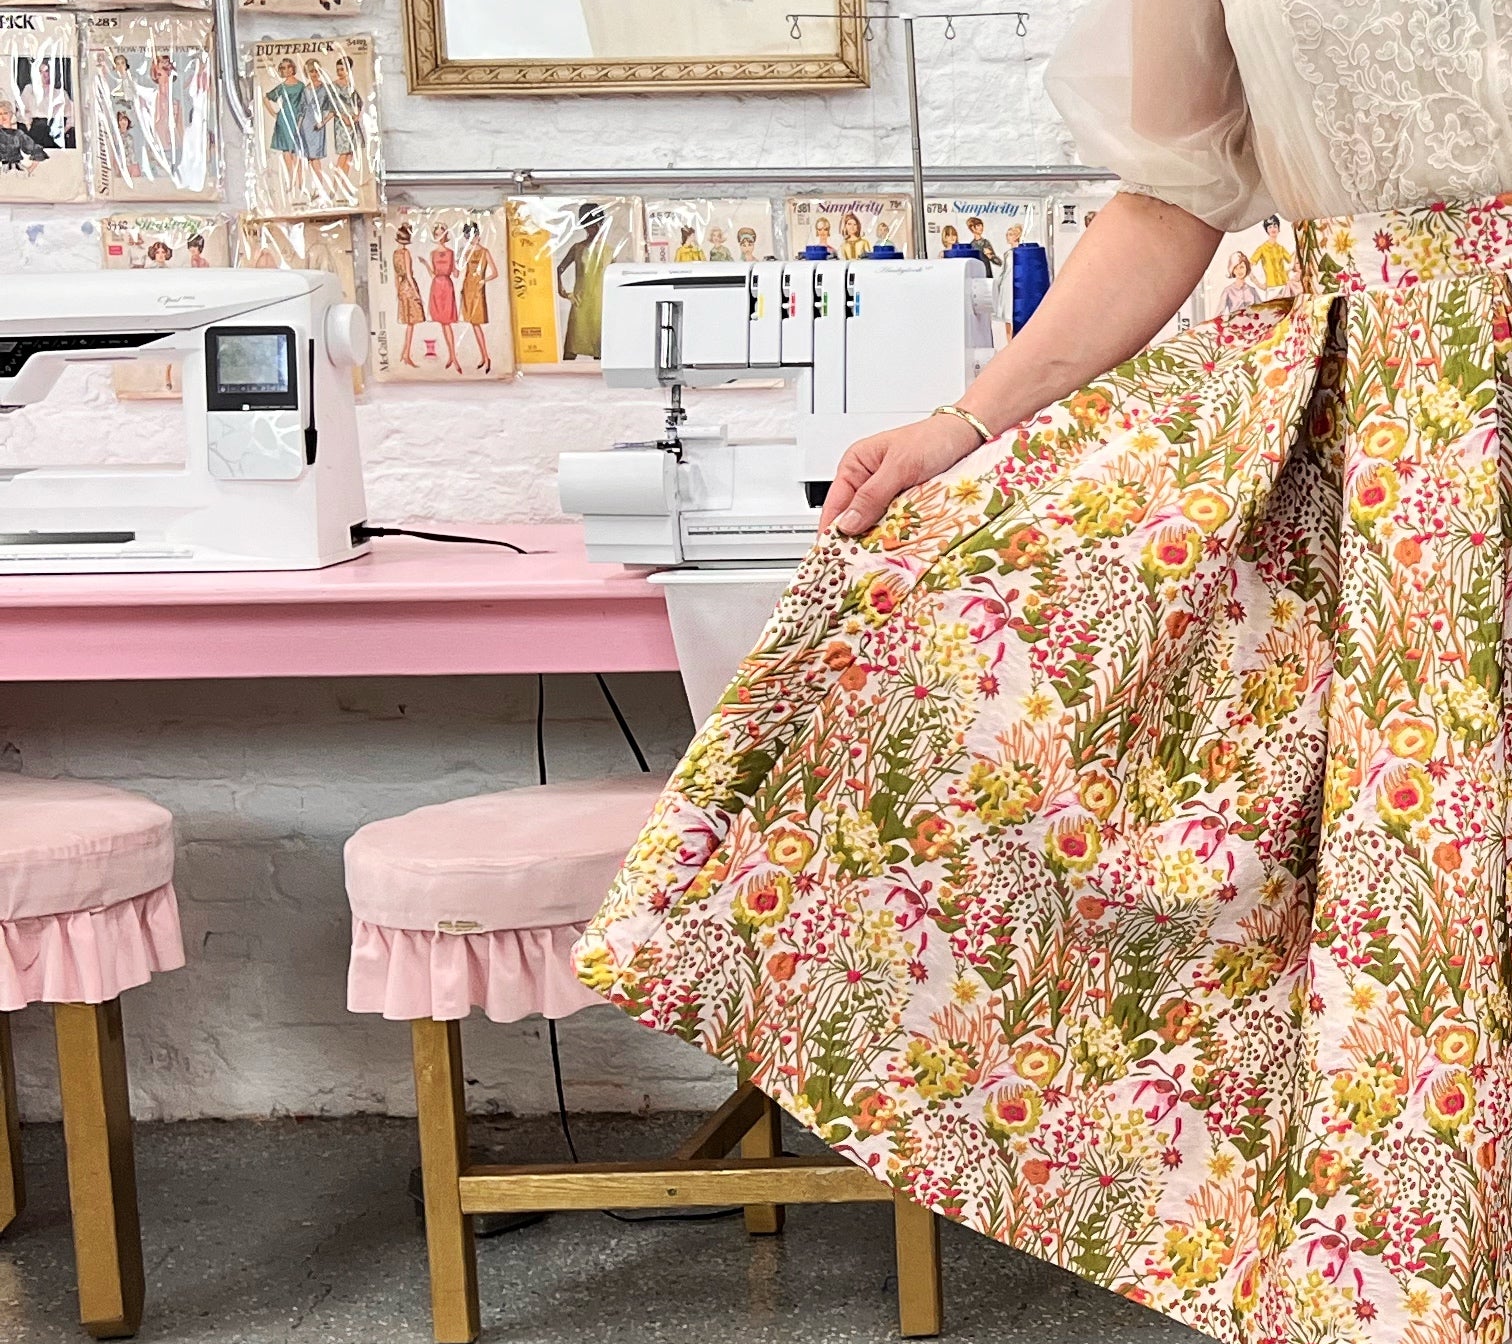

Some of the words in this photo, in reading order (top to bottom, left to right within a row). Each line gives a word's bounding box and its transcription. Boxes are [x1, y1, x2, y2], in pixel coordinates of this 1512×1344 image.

[256, 40, 335, 57] BUTTERICK
[819, 201, 884, 215] Simplicity
[953, 200, 1019, 217] Simplicity
